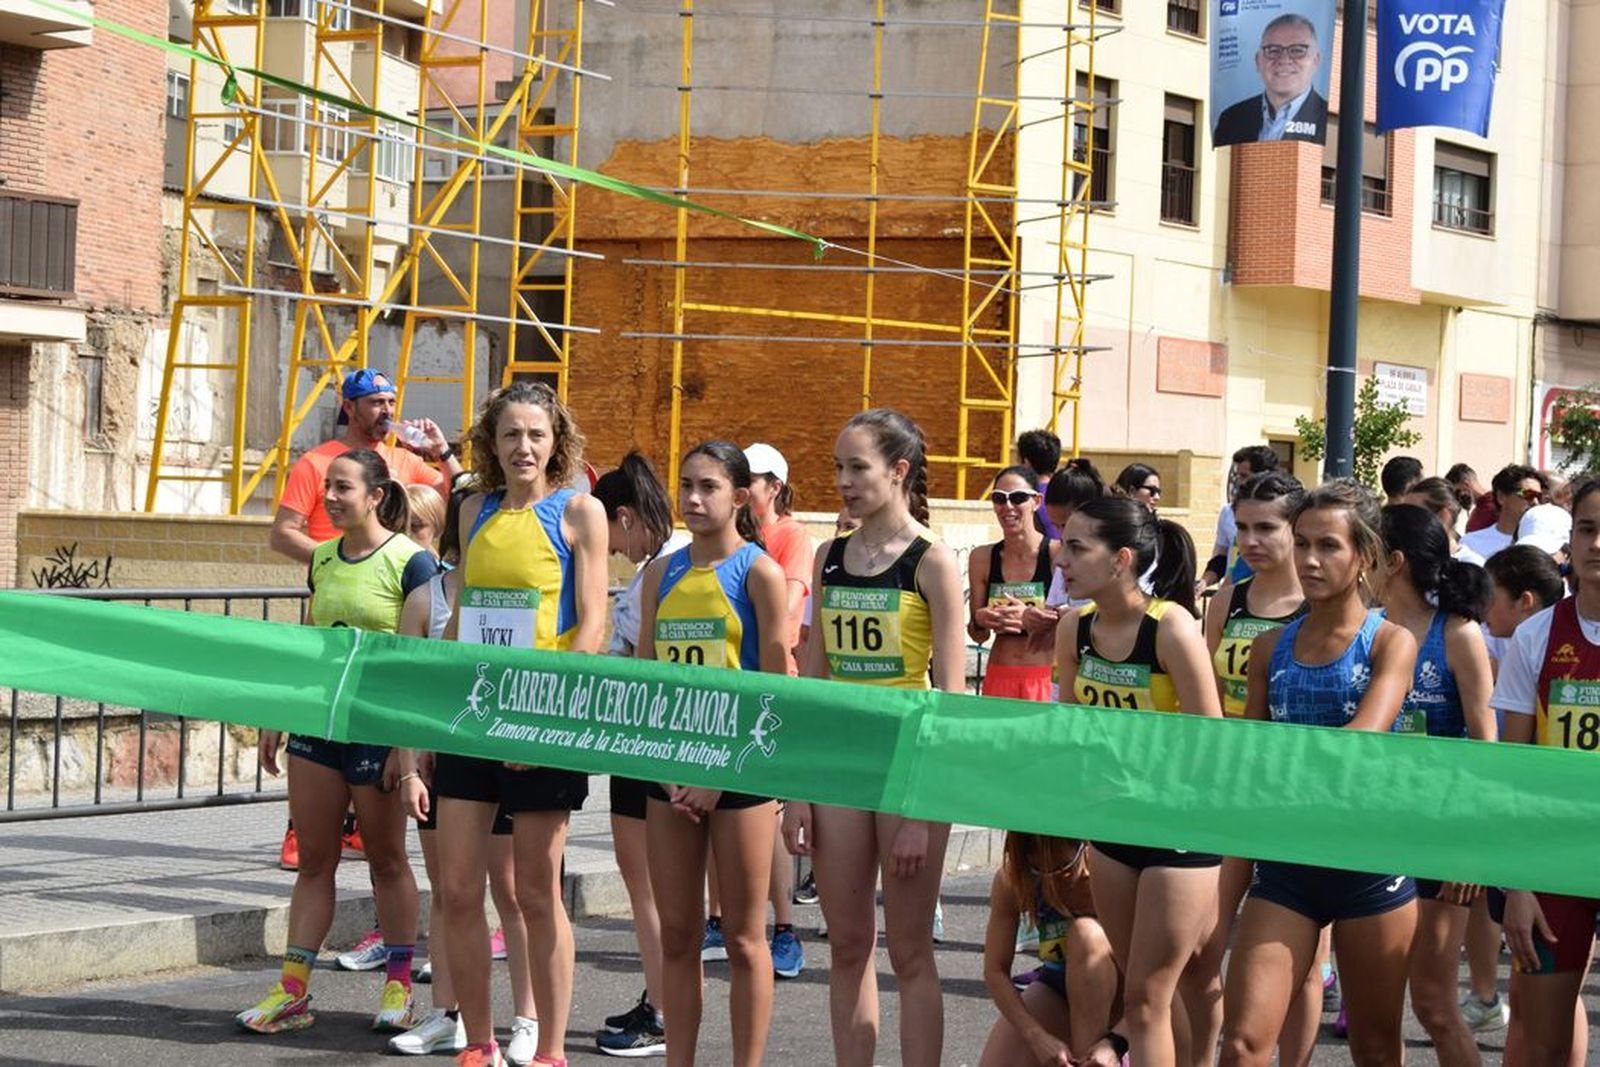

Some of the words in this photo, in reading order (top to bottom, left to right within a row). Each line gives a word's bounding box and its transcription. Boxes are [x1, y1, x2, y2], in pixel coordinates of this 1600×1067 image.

[1398, 13, 1476, 36] VOTA
[1285, 121, 1317, 136] 28M
[481, 627, 513, 647] VICKI
[831, 615, 883, 651] 116
[498, 668, 567, 716] CARRERA
[568, 674, 595, 720] del
[595, 678, 648, 727] CERCO
[648, 683, 668, 729] de
[669, 687, 739, 738] ZAMORA
[486, 717, 540, 742] Zamora
[539, 728, 577, 747] cerca
[576, 727, 595, 750] de
[594, 729, 611, 751] la
[609, 733, 675, 760] Esclerosis
[674, 740, 732, 770] Múltiple
